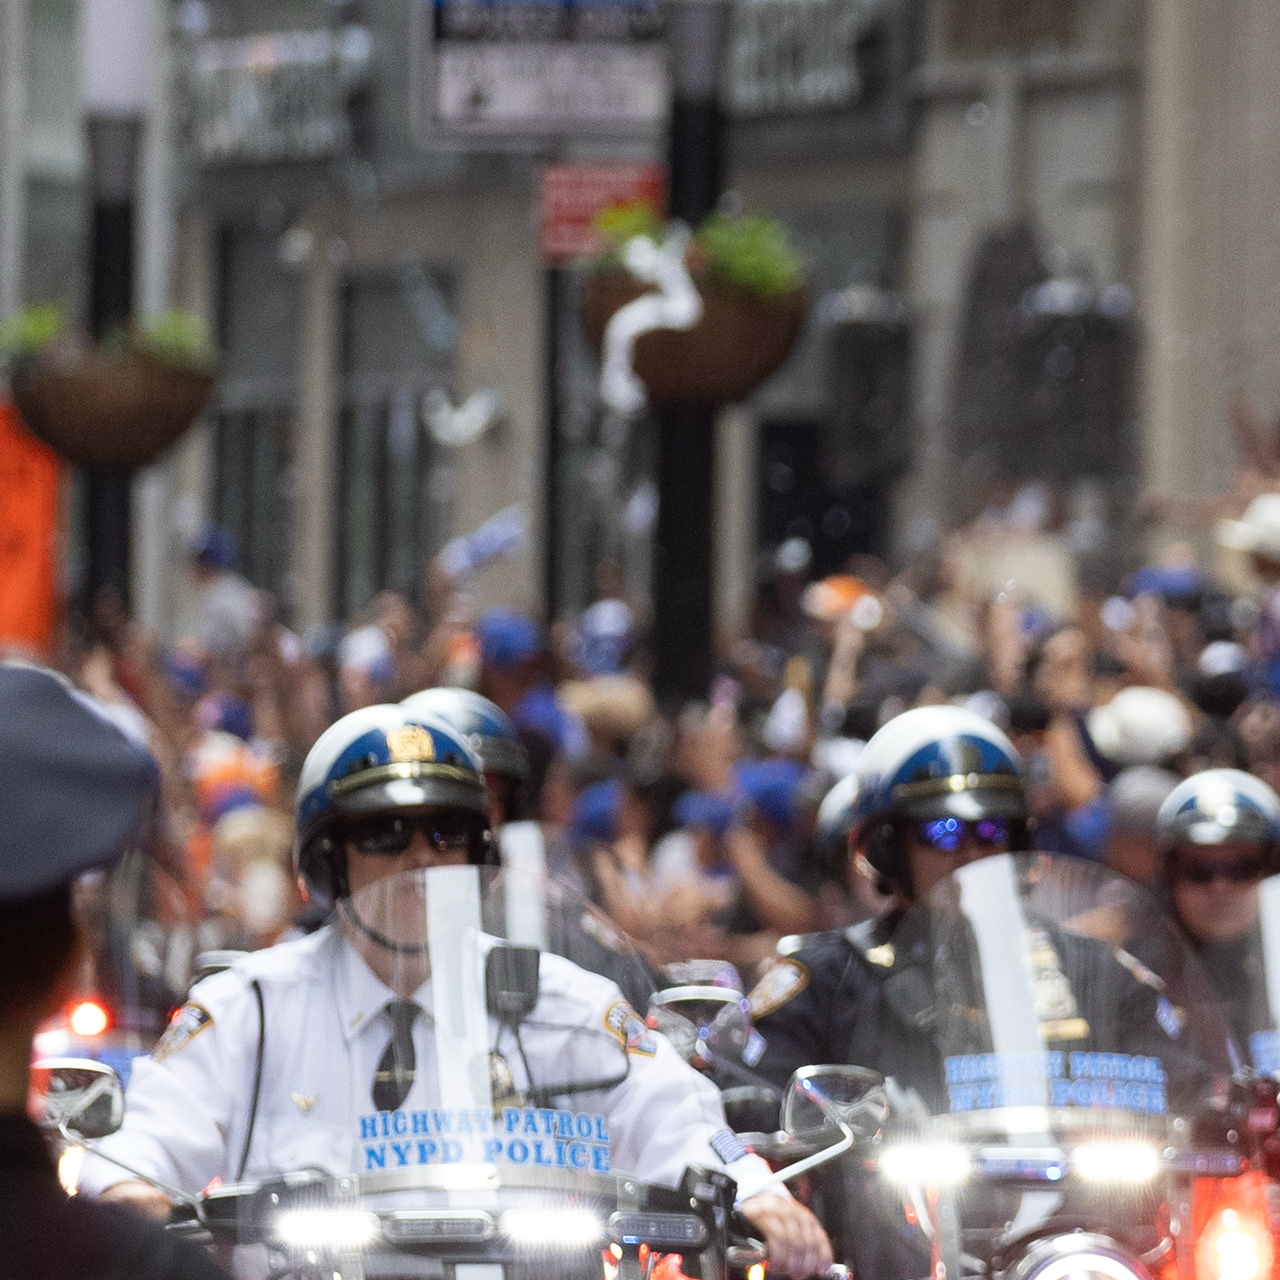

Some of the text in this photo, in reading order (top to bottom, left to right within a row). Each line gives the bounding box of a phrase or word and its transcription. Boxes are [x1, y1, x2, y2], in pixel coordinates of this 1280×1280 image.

[360, 1107, 610, 1143] HIGHWAY PATROL
[364, 1139, 610, 1173] NYPD POLICE
